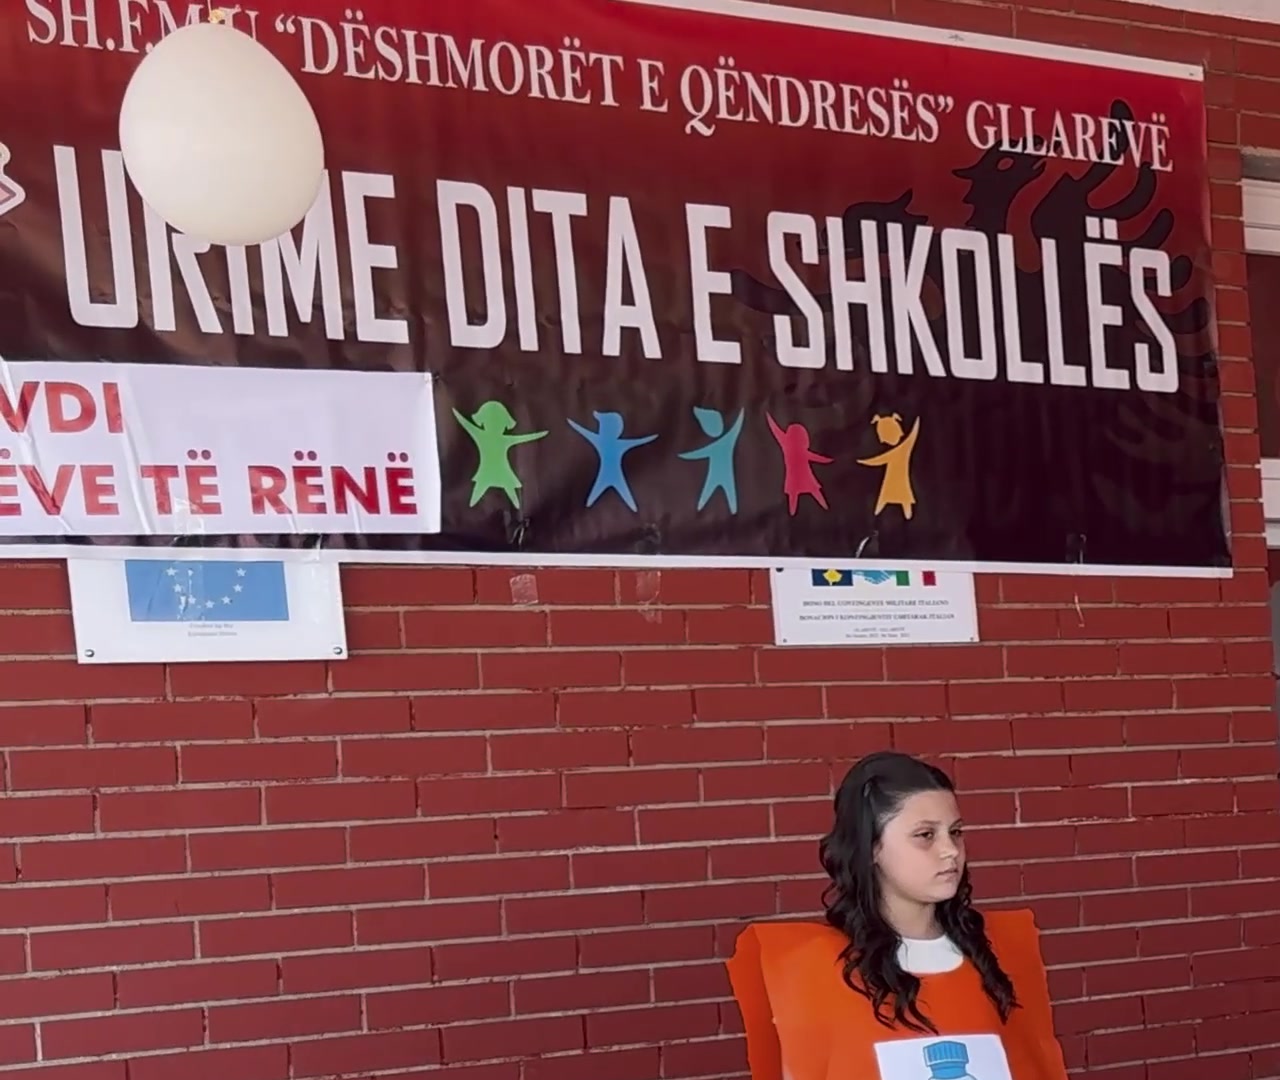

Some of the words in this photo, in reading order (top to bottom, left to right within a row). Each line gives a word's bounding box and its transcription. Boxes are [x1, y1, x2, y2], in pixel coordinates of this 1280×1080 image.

[638, 58, 669, 113] E
[680, 56, 953, 142] QËNDRESËS”
[966, 99, 1174, 172] GLLAREVË
[436, 179, 662, 360] DITA
[685, 203, 742, 364] E
[767, 211, 1180, 393] SHKOLLËS
[140, 449, 223, 515] TË
[248, 450, 418, 515] RËNË
